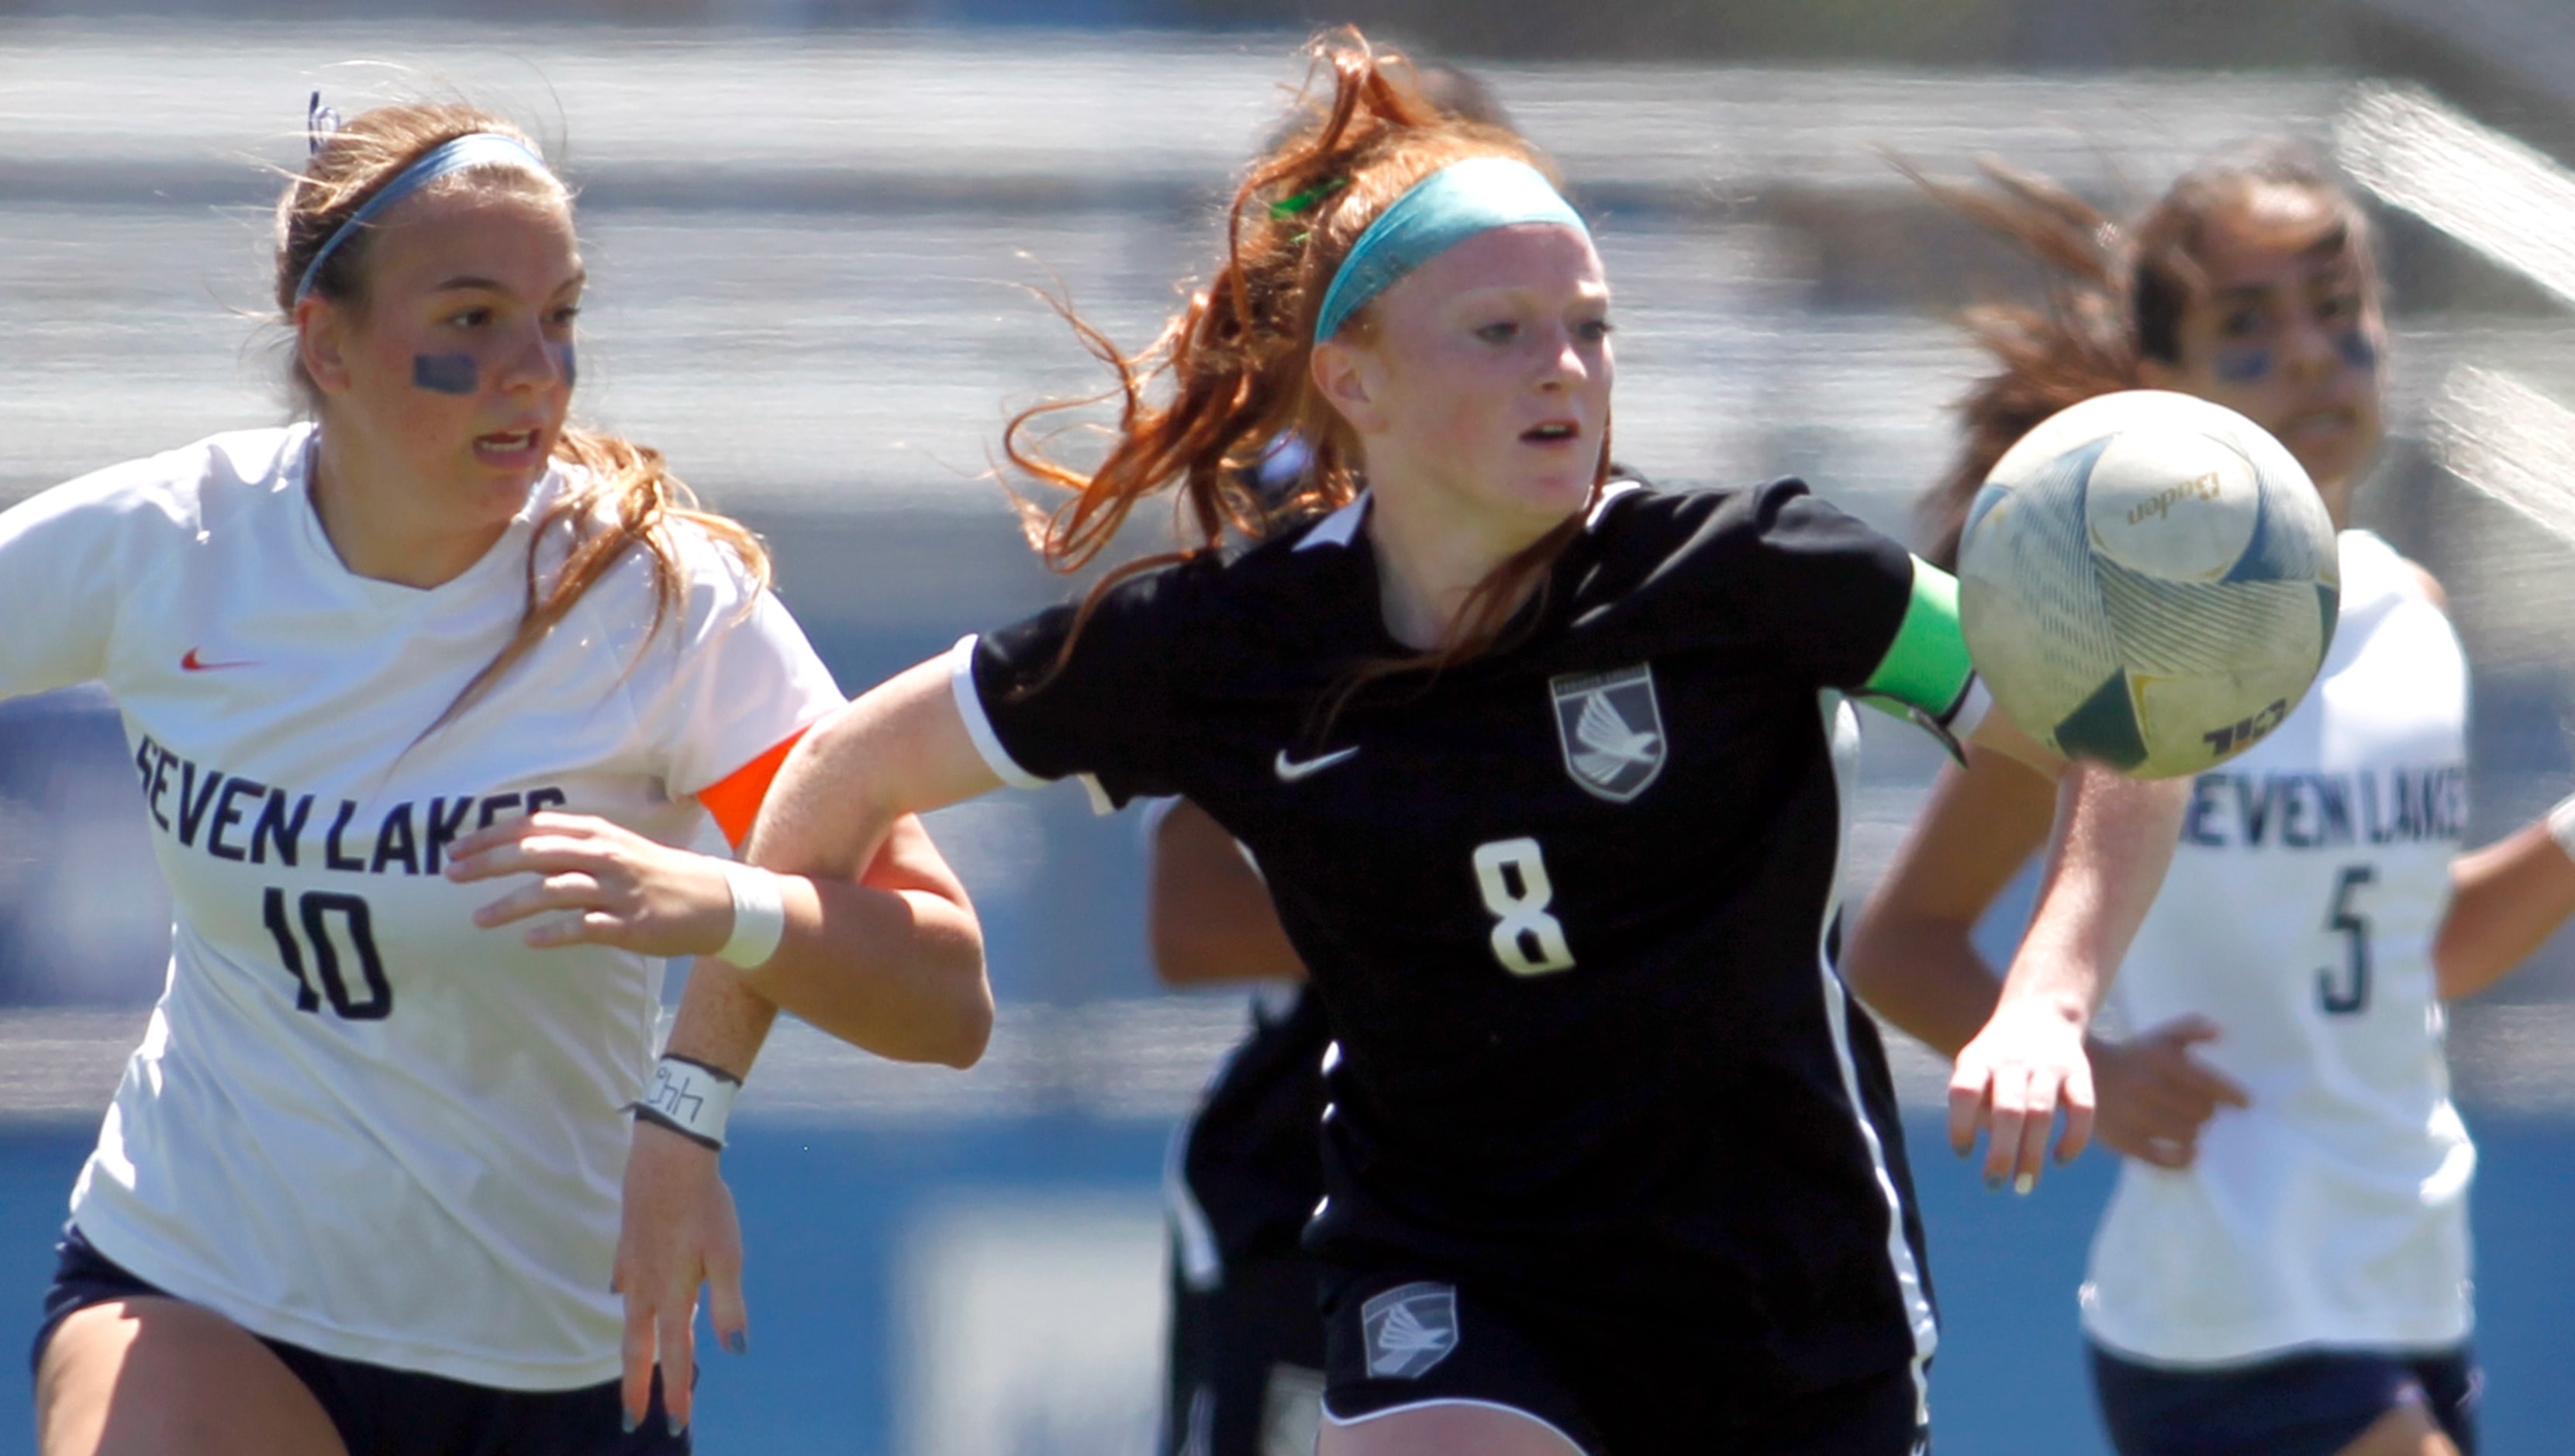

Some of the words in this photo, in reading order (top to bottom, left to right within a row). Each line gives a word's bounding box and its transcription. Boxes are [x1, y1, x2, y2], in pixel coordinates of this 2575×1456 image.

[135, 734, 316, 867] SEVEN
[2179, 771, 2354, 847] EVEN
[263, 886, 392, 1020] 10
[1472, 836, 1576, 977] 8
[2316, 862, 2376, 1013] 5
